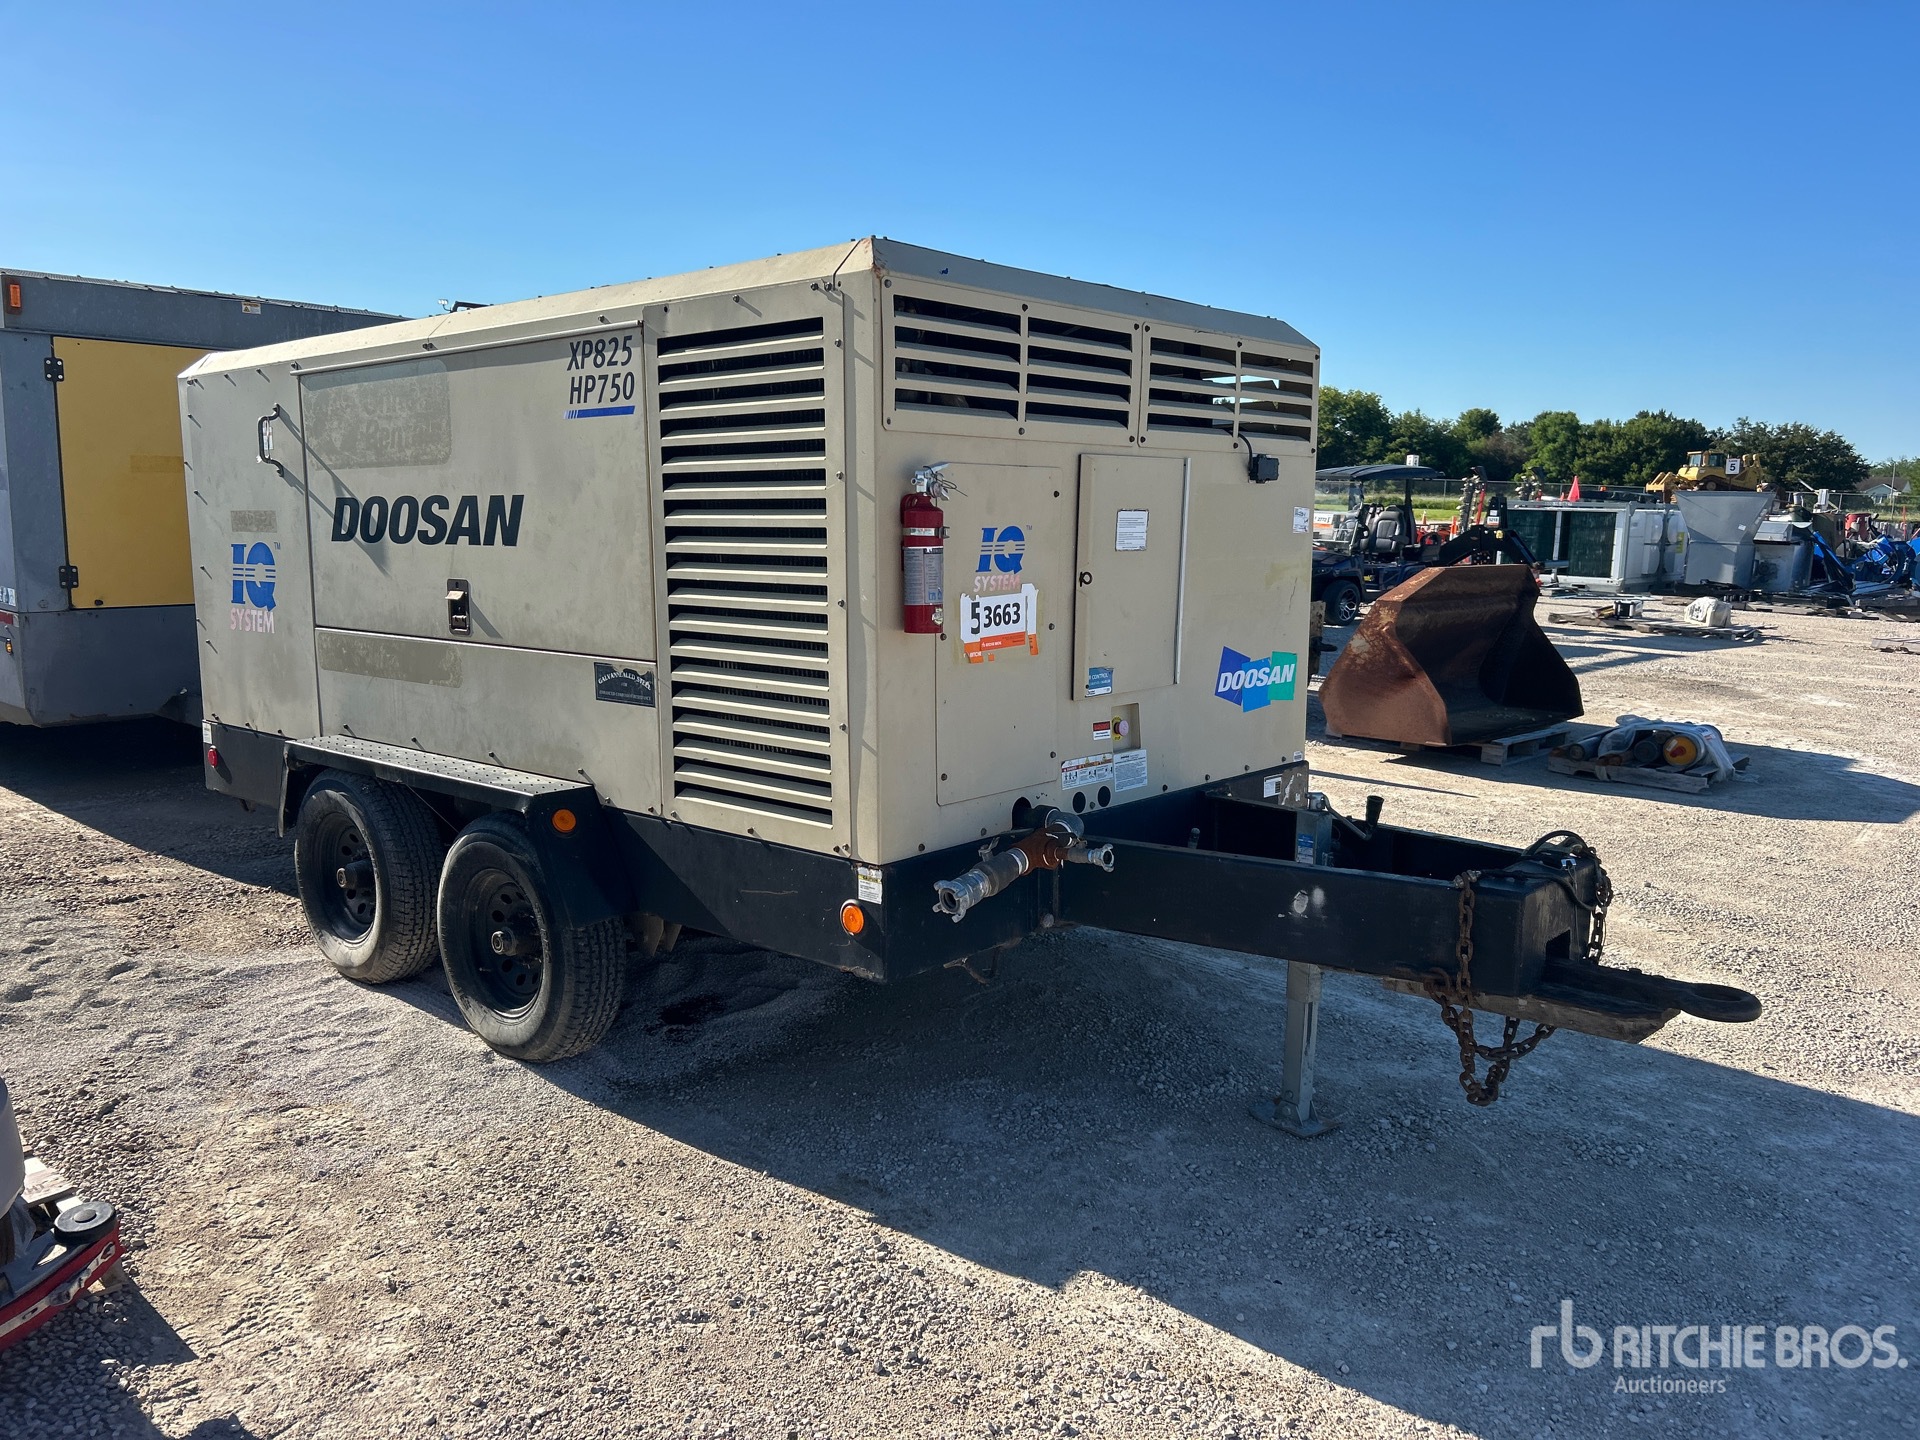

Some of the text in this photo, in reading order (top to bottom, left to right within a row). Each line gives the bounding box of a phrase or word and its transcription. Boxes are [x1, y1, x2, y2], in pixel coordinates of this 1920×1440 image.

[566, 335, 633, 371] XP825
[569, 371, 635, 405] HP750
[1729, 463, 1736, 471] 5
[331, 494, 525, 547] DOOSAN
[975, 525, 1026, 575] IQ
[230, 541, 277, 612] IQ
[973, 574, 1021, 593] SYSTEM
[229, 607, 275, 634] SYSTEM
[1217, 663, 1296, 693] DOOSAN
